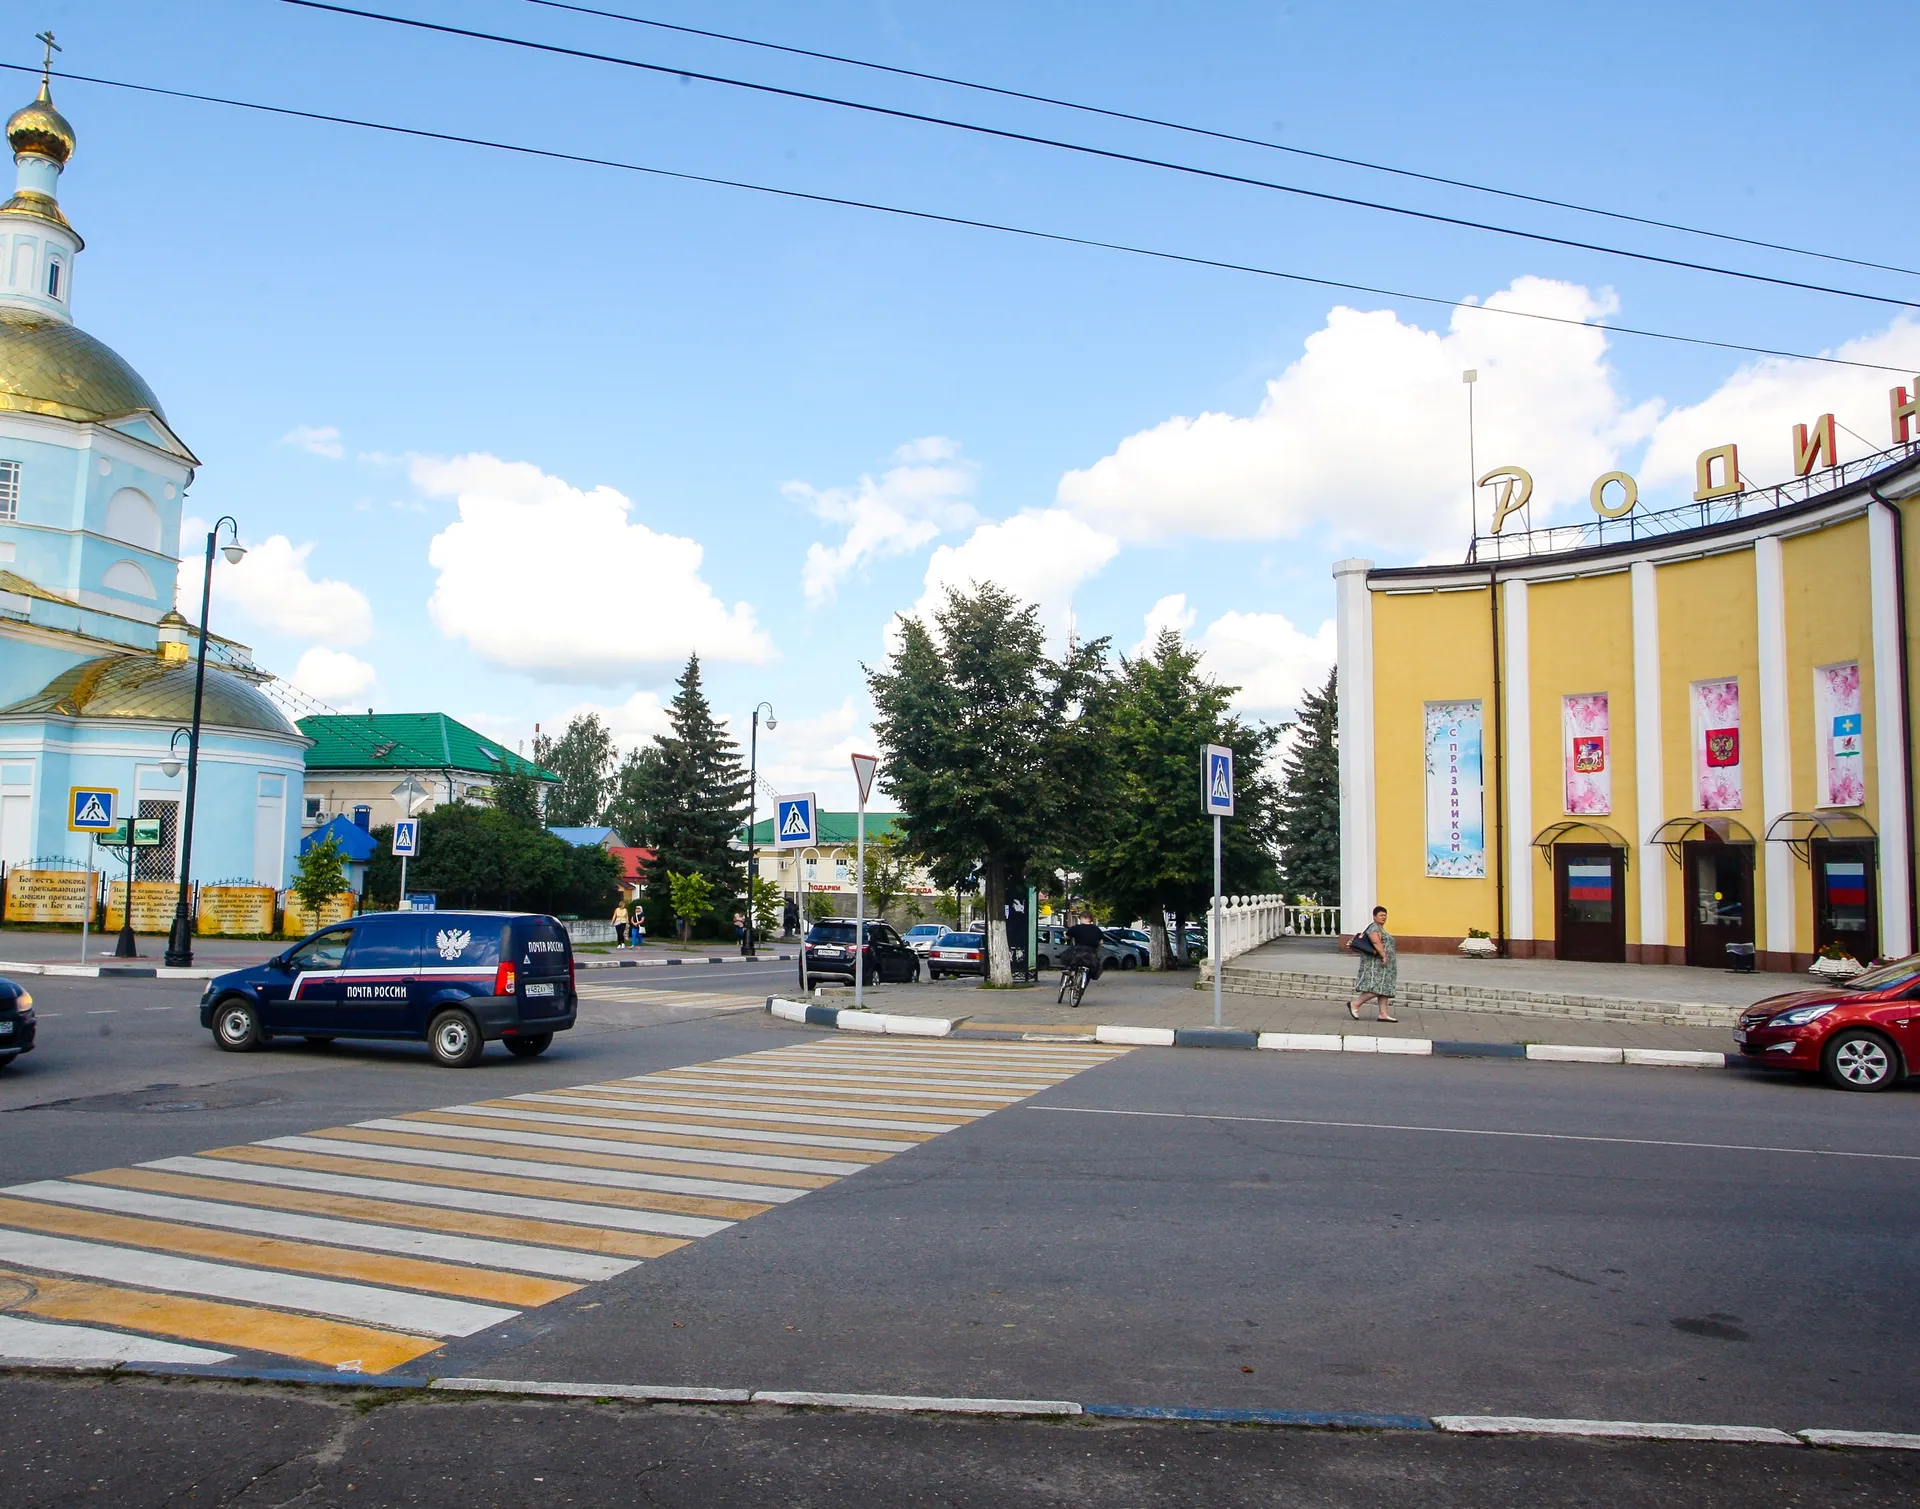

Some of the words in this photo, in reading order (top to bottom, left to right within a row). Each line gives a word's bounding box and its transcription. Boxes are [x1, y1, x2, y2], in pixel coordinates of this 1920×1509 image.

[1449, 728, 1457, 737] С
[1449, 743, 1460, 852] ПРАЗДНИКОМ
[19, 875, 33, 883] Бог
[528, 942, 547, 952] ПОЧТА
[347, 986, 372, 998] ПОЧТА
[374, 986, 406, 998] РОССИИ
